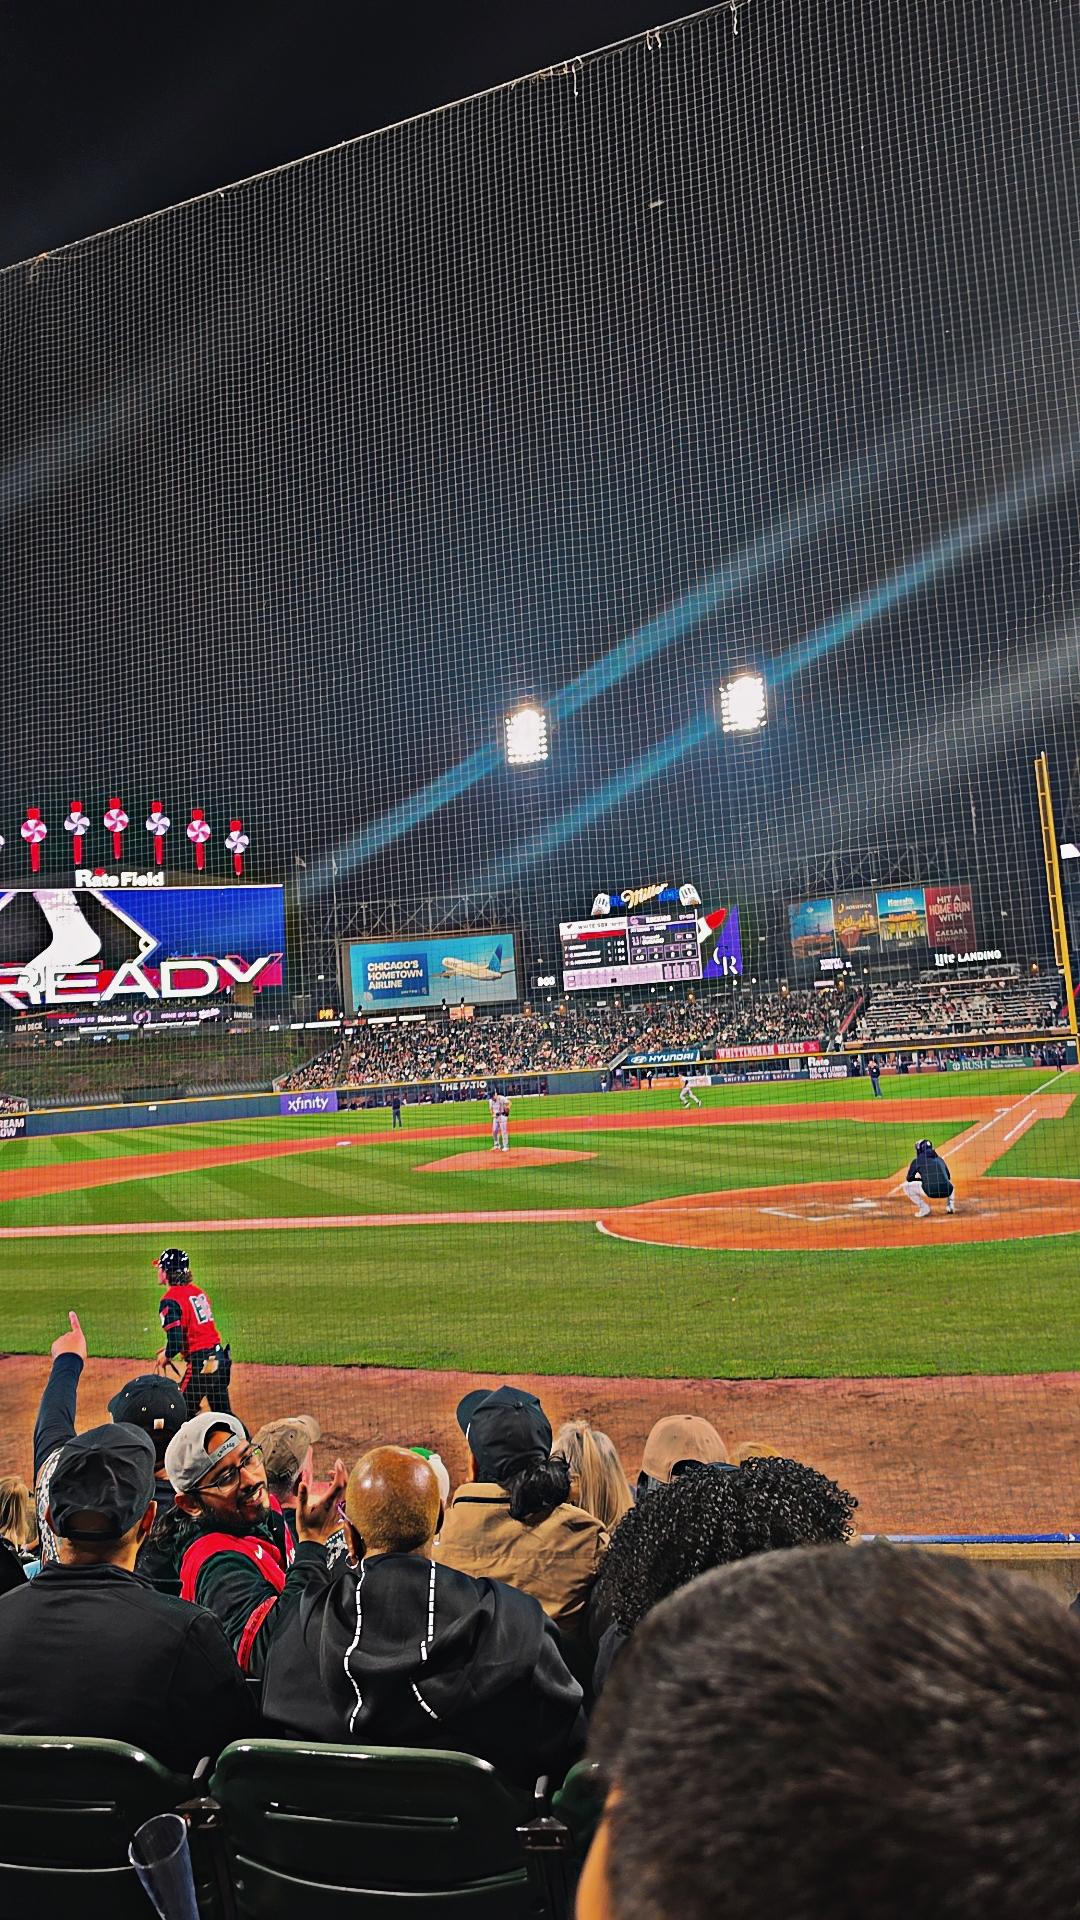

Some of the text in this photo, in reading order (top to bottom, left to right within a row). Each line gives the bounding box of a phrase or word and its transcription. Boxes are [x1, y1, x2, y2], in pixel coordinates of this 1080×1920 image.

[75, 869, 165, 887] Rate Field
[620, 882, 669, 909] Miller
[936, 894, 961, 904] HIT A
[929, 901, 971, 916] HOME RUN
[939, 912, 962, 922] WITH
[935, 928, 968, 937] CAESARS
[957, 949, 1002, 963] LANDING
[367, 960, 419, 971] CHICAGO'S
[367, 969, 423, 980] HOMETOWN
[368, 980, 403, 990] AIRLINE
[14, 1022, 43, 1032] FAN DECK
[717, 1044, 775, 1058] WHITTINGHAM
[777, 1042, 805, 1054] MEATS
[648, 1053, 694, 1063] HYUNDAI
[962, 1060, 988, 1070] RUSH
[440, 1083, 459, 1091] THE
[288, 1093, 329, 1112] xfinity
